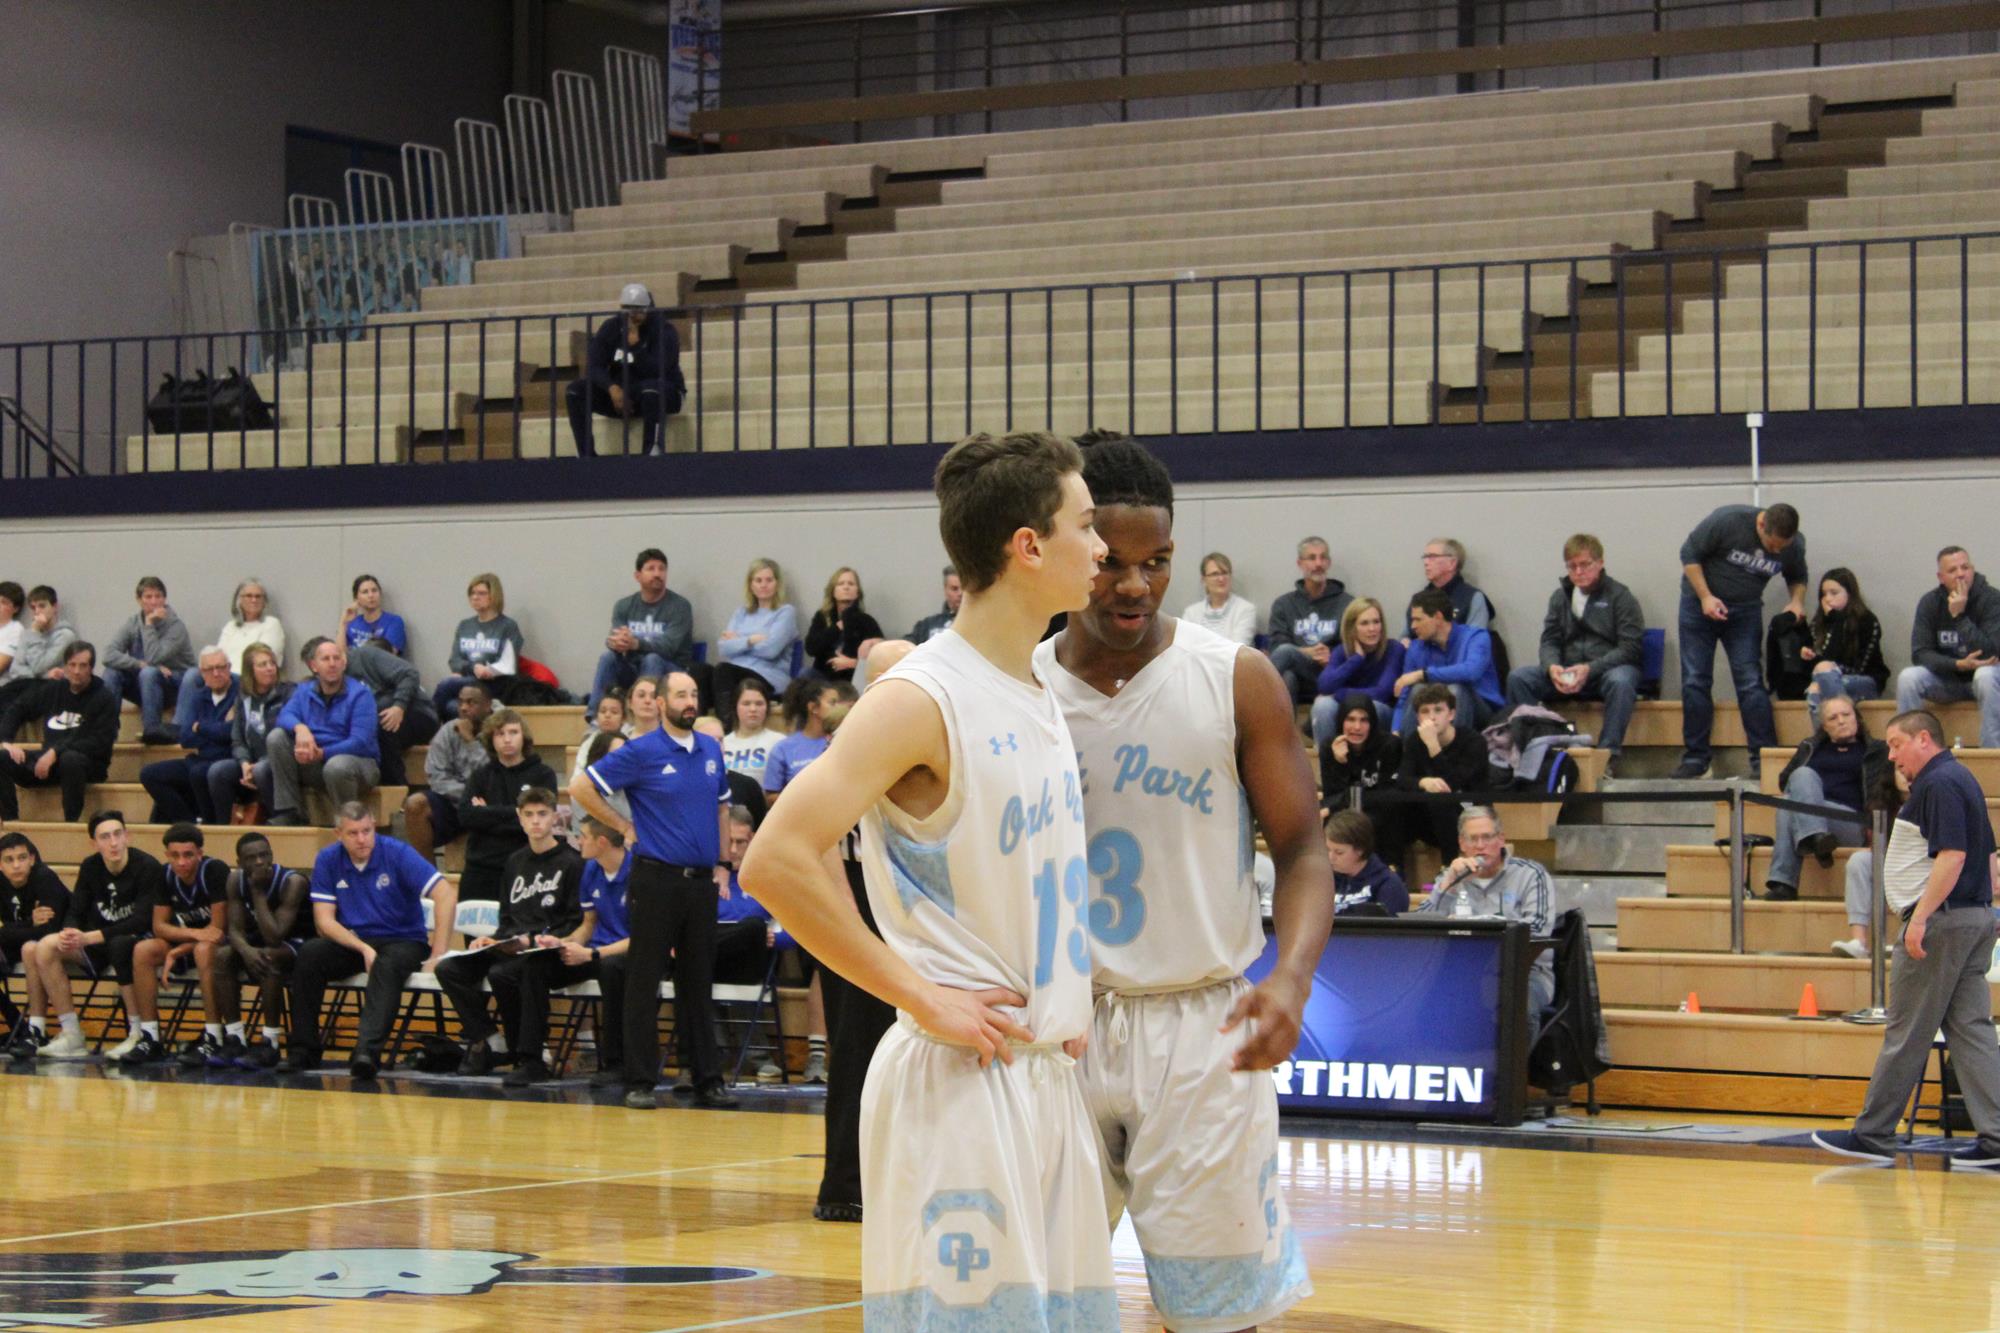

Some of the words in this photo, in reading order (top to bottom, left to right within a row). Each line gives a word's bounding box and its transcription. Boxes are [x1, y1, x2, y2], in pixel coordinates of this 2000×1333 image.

[724, 748, 768, 769] CHS
[1113, 744, 1213, 815] Park
[999, 777, 1054, 856] Oak
[510, 870, 562, 903] Central
[1087, 827, 1147, 947] 3
[1033, 855, 1092, 990] 13
[1272, 1060, 1484, 1103] RTHMEN
